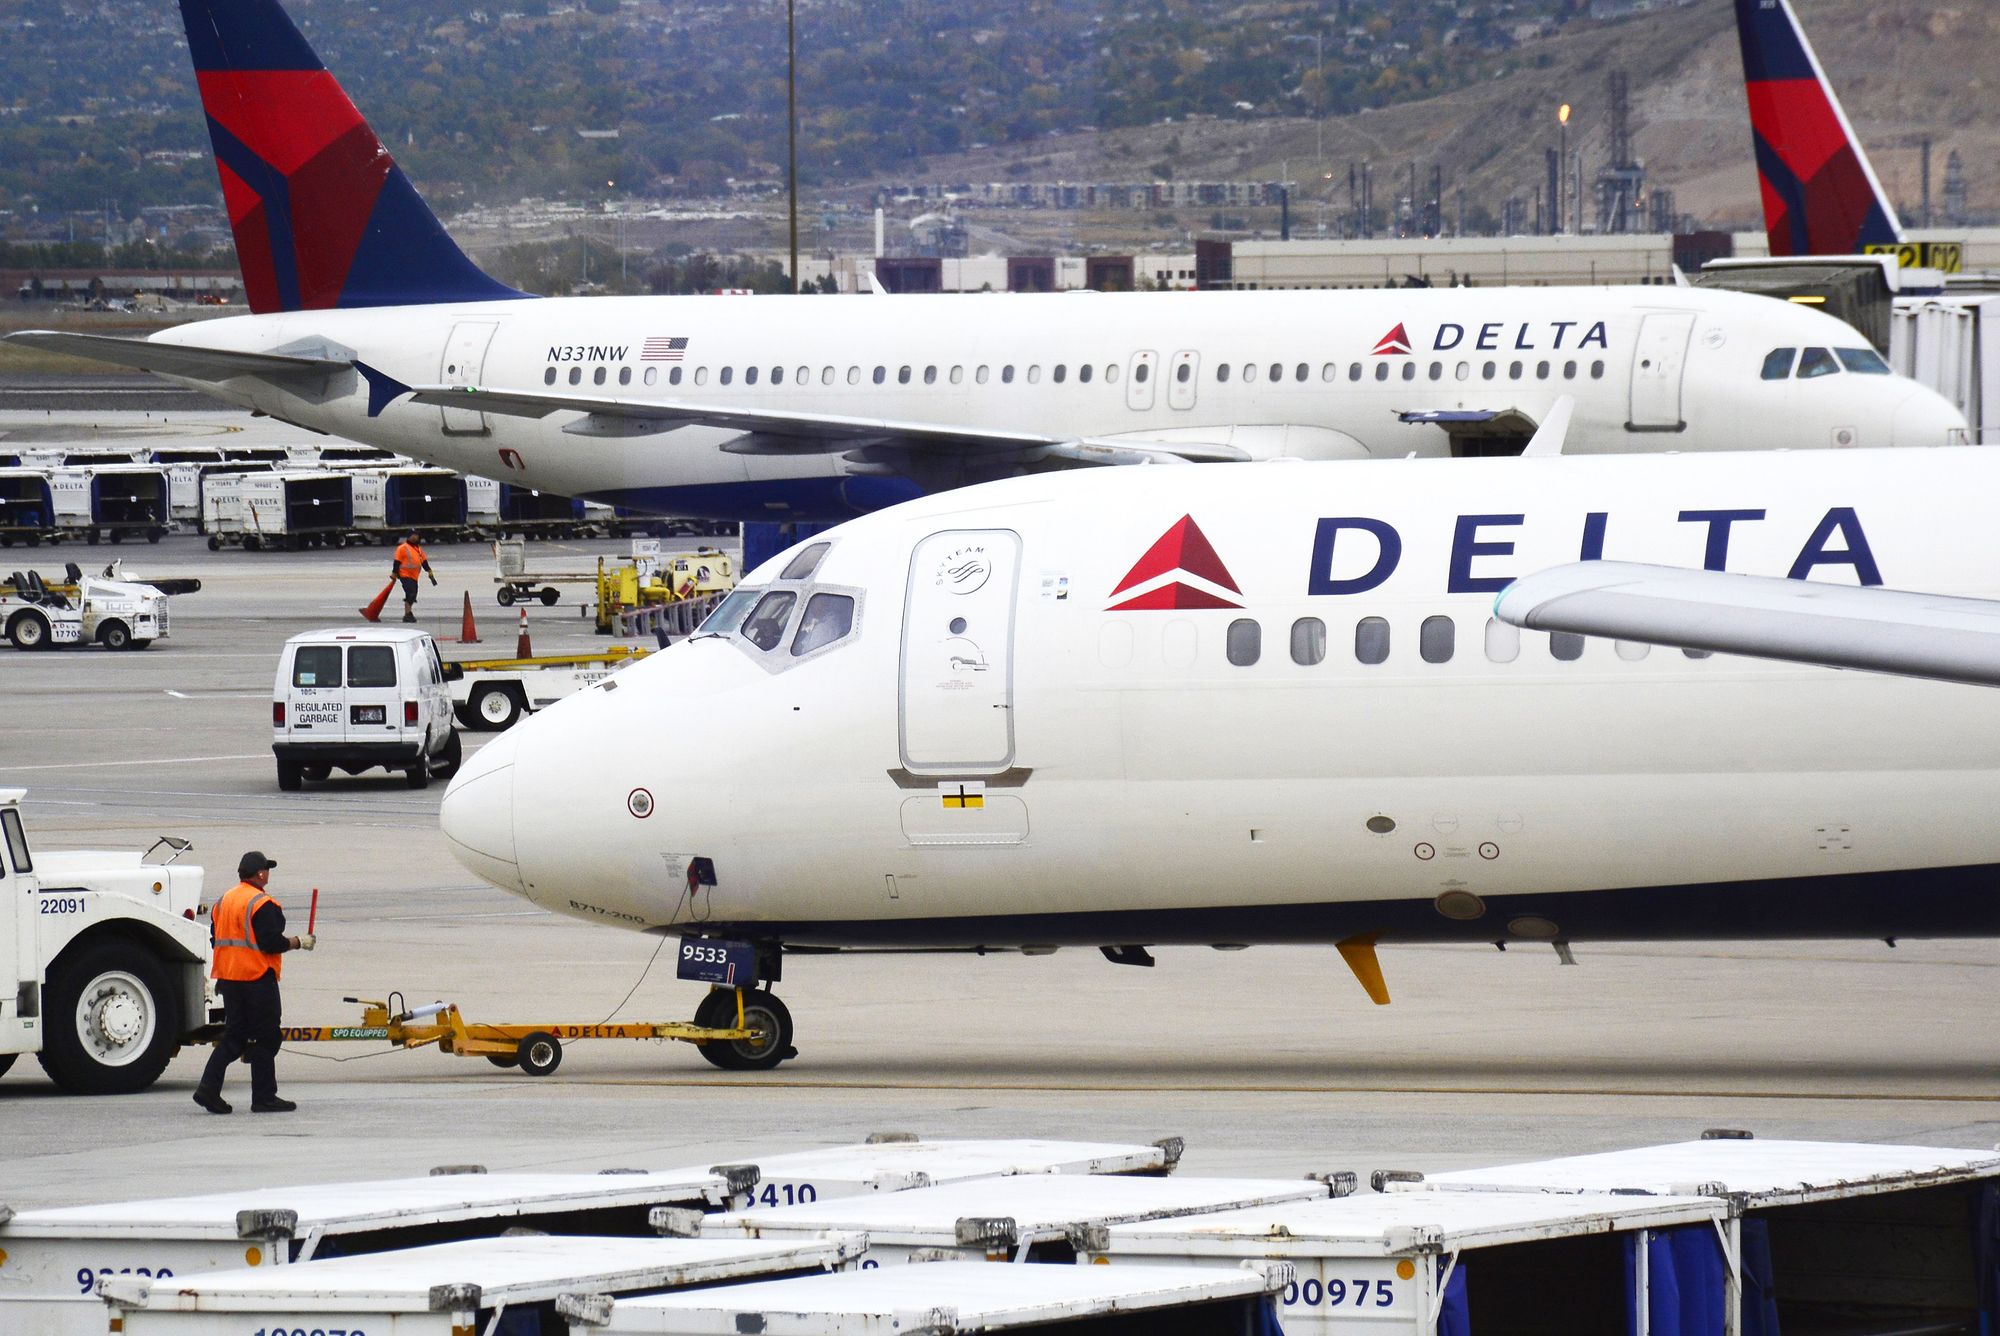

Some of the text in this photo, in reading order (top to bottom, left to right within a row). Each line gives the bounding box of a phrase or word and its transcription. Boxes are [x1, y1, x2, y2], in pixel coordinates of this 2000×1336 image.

[1433, 321, 1608, 350] DELTA
[547, 345, 629, 362] N331NW
[936, 546, 985, 586] SKYTEAM
[295, 702, 343, 712] REGULATED
[299, 713, 339, 723] GARBAGE
[40, 898, 86, 914] 22091
[569, 899, 646, 925] B717-200
[683, 945, 728, 964] 9533
[333, 1028, 349, 1039] SPD
[350, 1028, 388, 1038] EQUIPPED
[569, 1026, 626, 1038] DELTA
